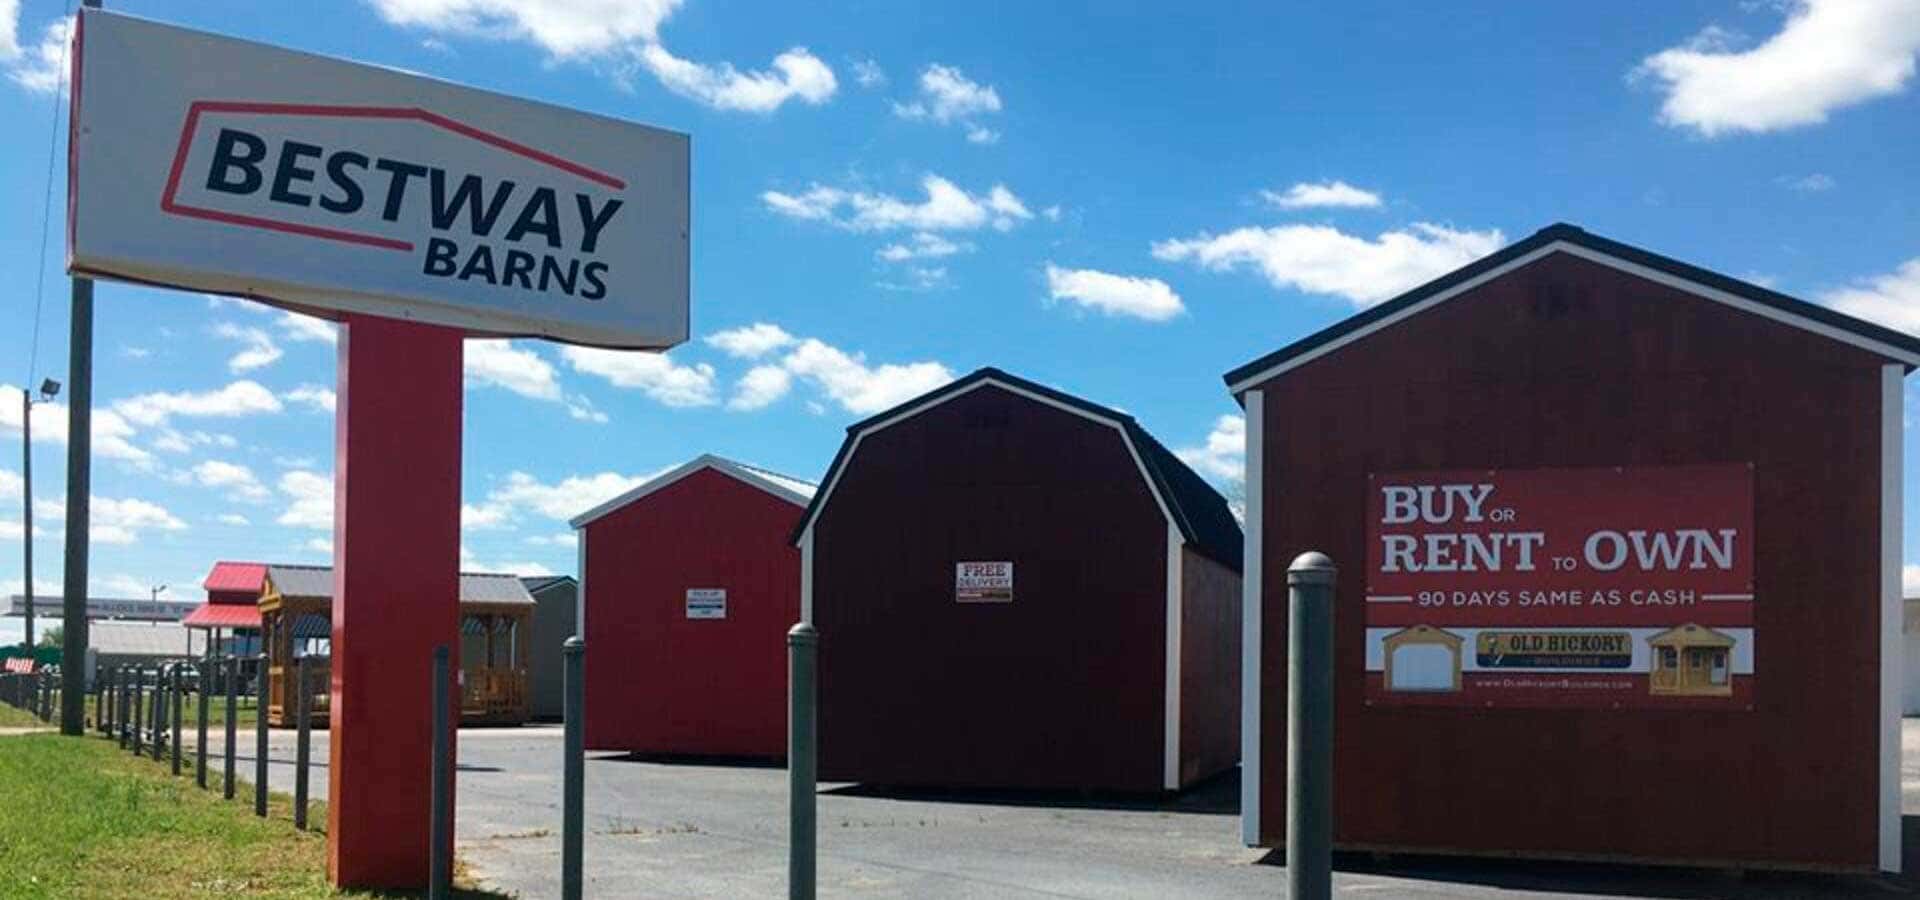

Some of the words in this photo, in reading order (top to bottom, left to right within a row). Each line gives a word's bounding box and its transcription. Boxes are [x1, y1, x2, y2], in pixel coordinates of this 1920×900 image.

[206, 128, 624, 253] BESTWAY
[423, 238, 608, 300] BARNS
[1381, 484, 1494, 524] BUY
[1490, 508, 1515, 523] OR
[963, 564, 1005, 577] FREE
[1381, 532, 1544, 572] RENT
[1552, 557, 1577, 571] TO
[1584, 529, 1736, 571] OWN
[1418, 591, 1445, 606] 90
[1453, 591, 1511, 606] DAYS
[1519, 591, 1582, 606] SAME
[1591, 590, 1621, 605] AS
[1630, 590, 1695, 605] CASH
[1510, 633, 1543, 651] OLD
[1548, 633, 1625, 651] HICKORY
